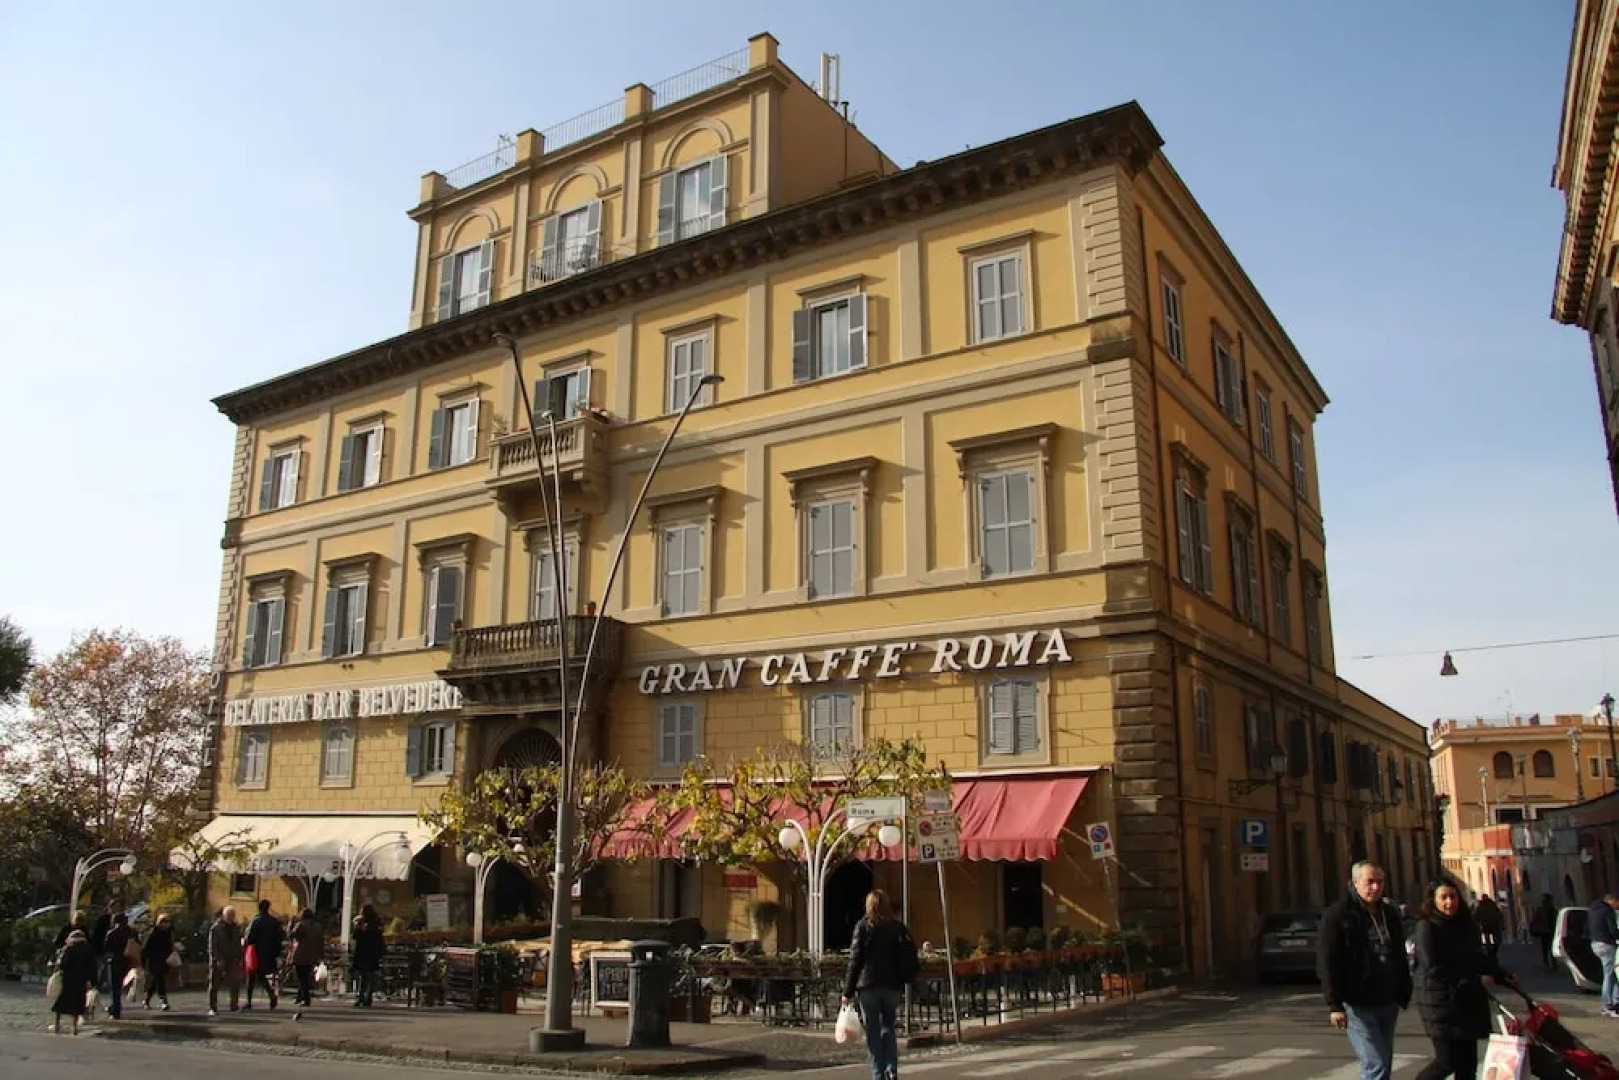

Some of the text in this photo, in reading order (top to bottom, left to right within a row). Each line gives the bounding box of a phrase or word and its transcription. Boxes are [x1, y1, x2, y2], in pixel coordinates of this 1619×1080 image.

[639, 657, 746, 694] GRAN
[929, 628, 1073, 673] ROMA
[225, 679, 464, 726] GELATERIA BAR BELVEDERE
[1246, 821, 1264, 843] P
